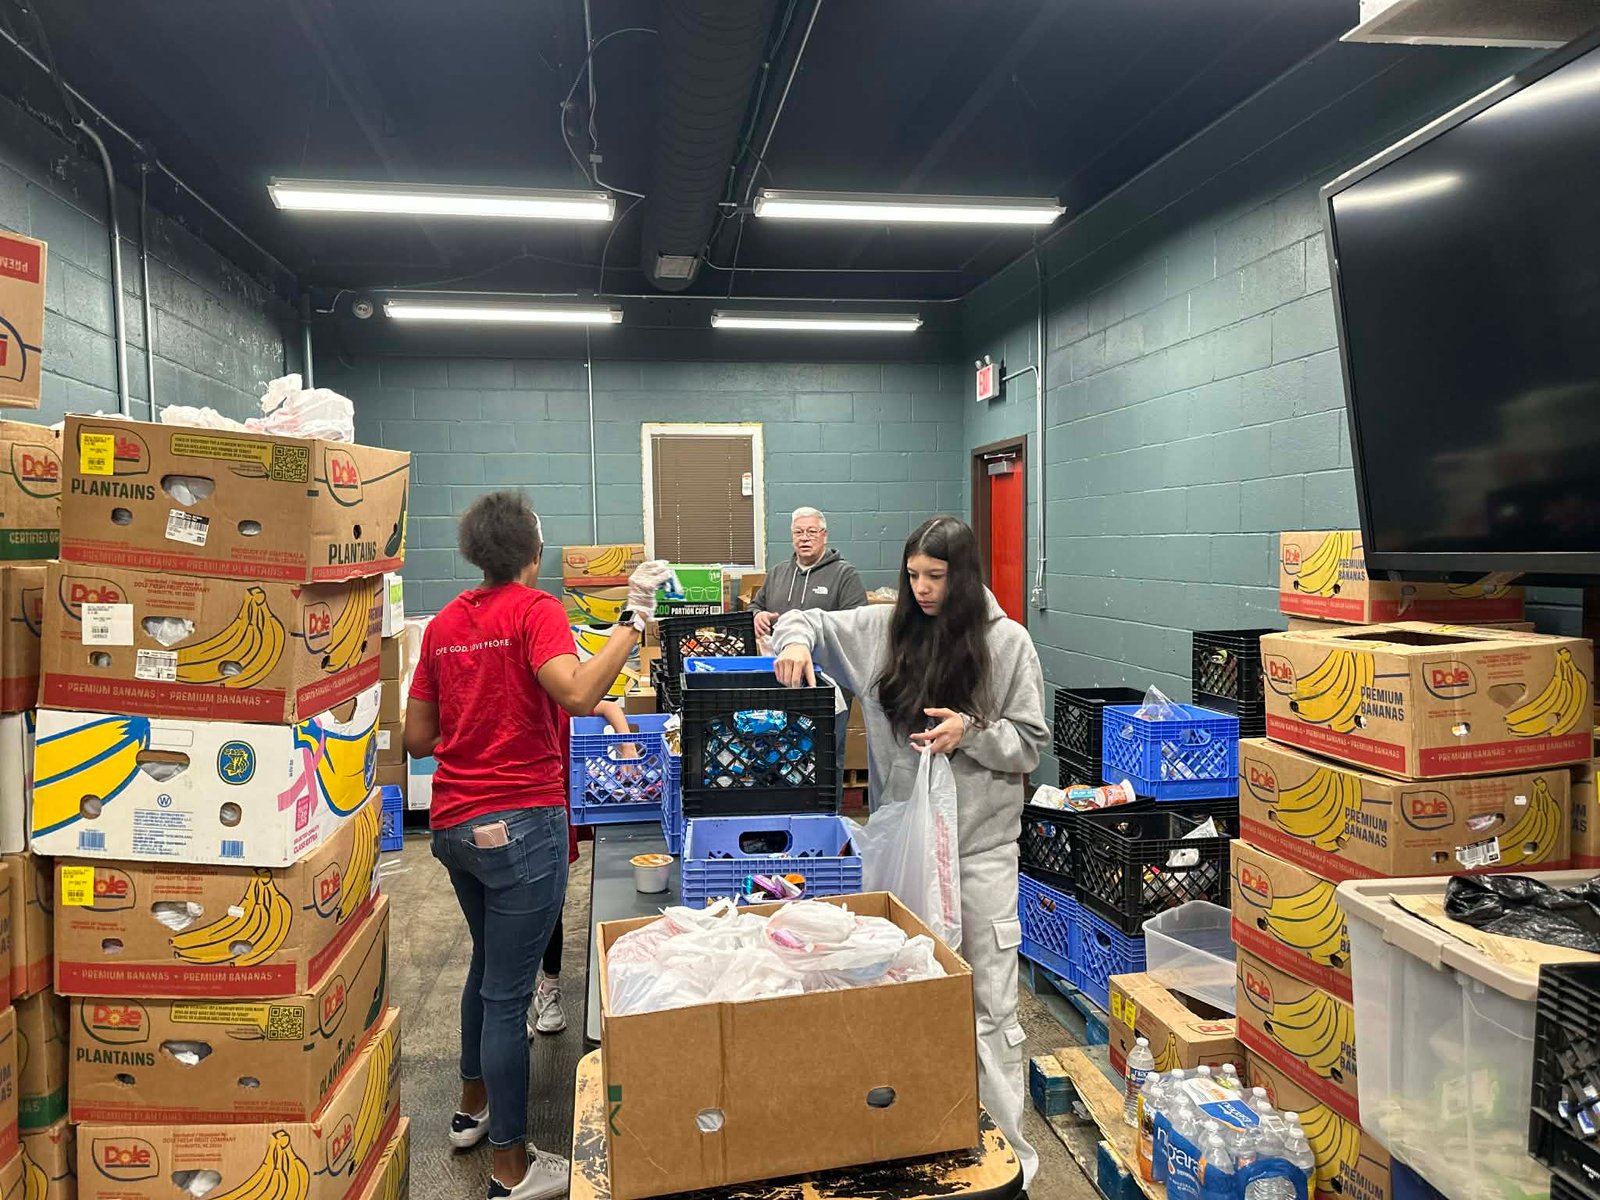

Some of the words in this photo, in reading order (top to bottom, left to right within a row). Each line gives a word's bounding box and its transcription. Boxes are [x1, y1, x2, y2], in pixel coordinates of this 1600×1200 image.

[114, 437, 141, 459] ole
[22, 454, 59, 476] Dole
[331, 459, 357, 485] Dole
[71, 478, 155, 501] PLANTAINS
[328, 541, 377, 565] PLANTAINS
[1338, 559, 1365, 569] PREMIUM
[1338, 570, 1366, 581] BANANAS
[71, 584, 120, 604] Dole
[309, 610, 330, 634] Dole
[671, 607, 694, 615] PORTION
[695, 607, 709, 615] CUPS
[1269, 660, 1293, 680] Dole
[1431, 668, 1469, 685] Dole
[67, 682, 111, 696] PREMIUM
[112, 686, 156, 700] BANANAS
[169, 691, 214, 703] PREMIUM
[216, 694, 261, 706] BANANAS
[1361, 686, 1403, 706] PREMIUM
[1361, 703, 1404, 721] BANANAS
[1251, 767, 1275, 789] Dole
[1412, 799, 1448, 815] Dole
[1345, 807, 1388, 833] PREMIUM
[1345, 822, 1388, 848] BANANAS
[94, 875, 129, 895] ole
[1241, 867, 1269, 895] Dole
[82, 970, 125, 980] PREMIUM
[126, 970, 170, 981] BANANAS
[183, 971, 227, 982] PREMIUM
[229, 971, 273, 982] BANANAS
[1246, 972, 1271, 1001] Dole
[93, 1004, 143, 1026] Dole
[76, 1048, 155, 1066] PLANTAINS
[104, 1145, 150, 1164] Dole
[1340, 1159, 1384, 1200] PREMIUM
